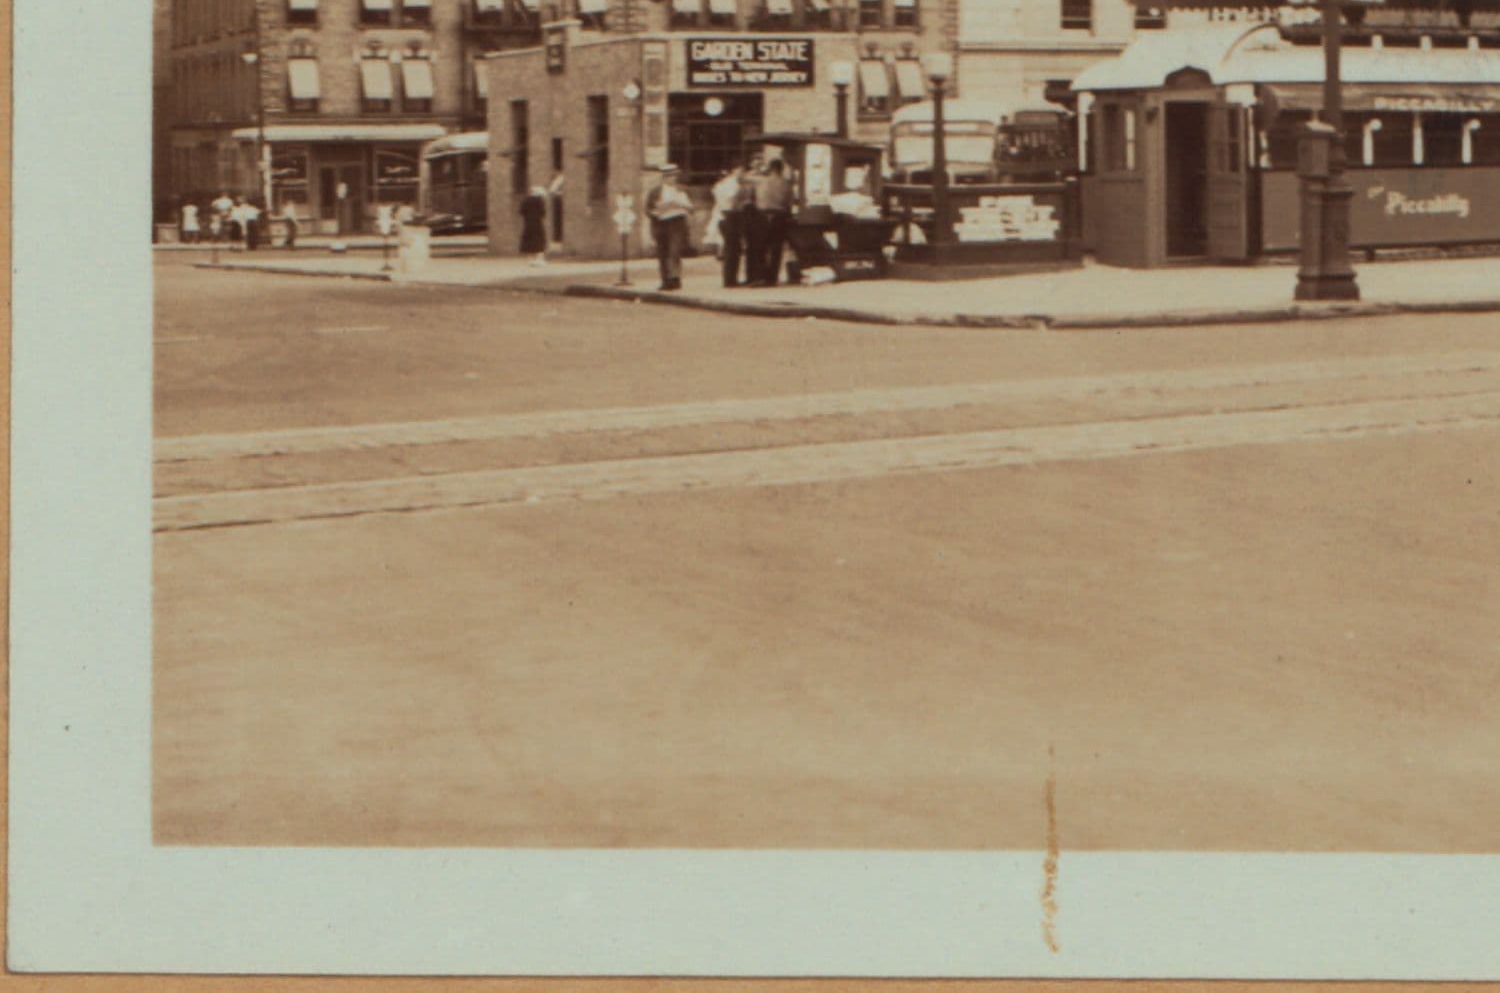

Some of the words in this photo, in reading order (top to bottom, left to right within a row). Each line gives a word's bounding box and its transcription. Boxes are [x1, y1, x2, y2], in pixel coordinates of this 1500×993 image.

[691, 41, 753, 62] GARDEN
[757, 41, 809, 62] STATE
[1374, 96, 1495, 112] PICCADILLY
